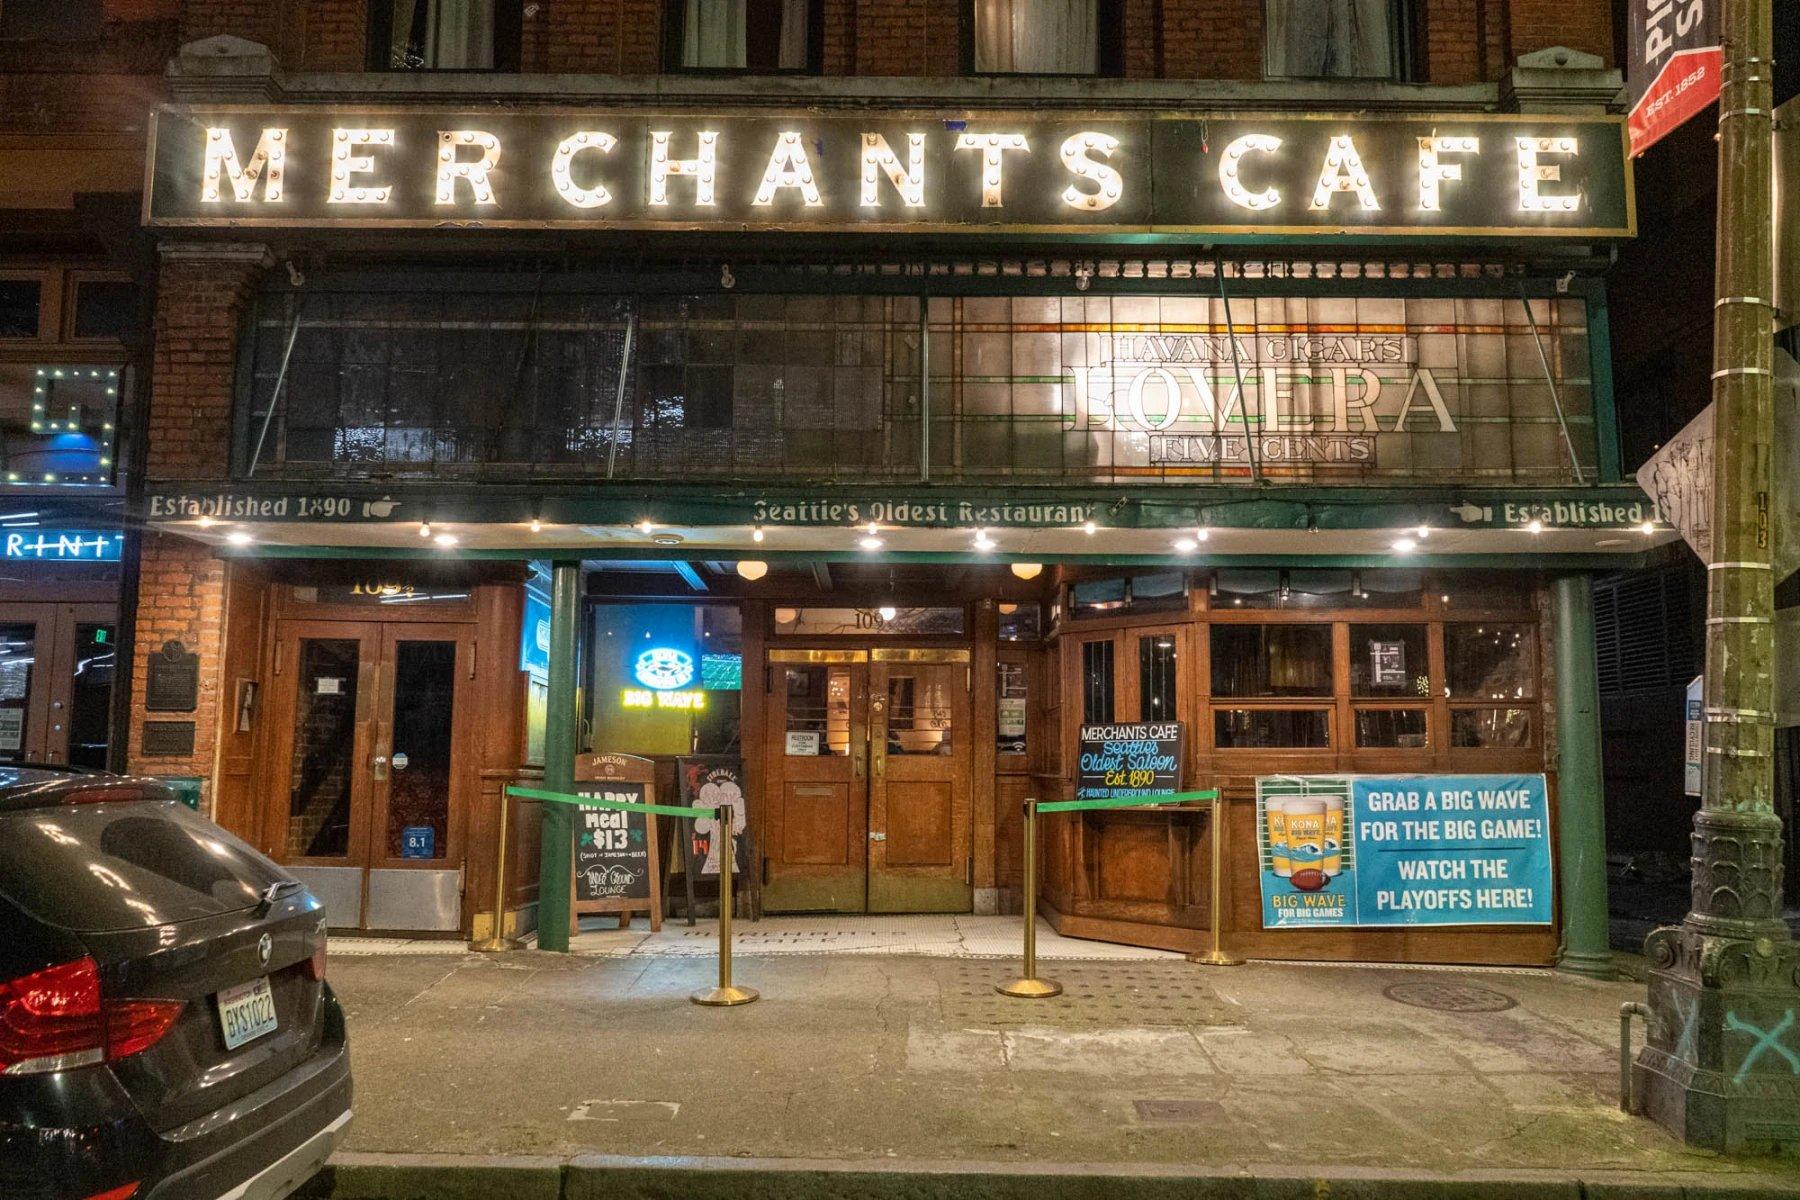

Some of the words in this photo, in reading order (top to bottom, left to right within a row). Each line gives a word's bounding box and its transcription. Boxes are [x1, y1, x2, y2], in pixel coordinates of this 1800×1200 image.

[1645, 90, 1674, 118] EST.
[201, 127, 1124, 211] MERCHANTS
[1218, 133, 1582, 212] CAFE
[1114, 336, 1252, 363] HAVANA
[1266, 336, 1402, 362] CIGARS
[1160, 435, 1240, 462] FIVE
[1262, 435, 1370, 461] CENTS
[150, 496, 288, 517] Established
[754, 501, 859, 521] Seattle's
[870, 501, 947, 521] Oldest
[960, 501, 1096, 522] Restaurant
[1504, 501, 1642, 523] Established
[854, 611, 884, 630] 109
[1081, 726, 1147, 740] MERCHANTS
[1149, 725, 1178, 739] CAFE
[592, 756, 627, 767] JAMESON
[1080, 753, 1125, 772] Oldest
[1127, 754, 1178, 771] Saloon
[1128, 770, 1155, 788] 1890
[1368, 791, 1421, 813] GRAB
[1424, 791, 1438, 811] A
[1441, 790, 1474, 811] BIG
[1477, 789, 1532, 810] WAVE
[1291, 819, 1320, 830] KONA
[1360, 821, 1399, 842] FOR
[1402, 821, 1441, 841] THE
[1444, 819, 1477, 840] BIG
[1481, 818, 1542, 840] GAME!
[409, 837, 425, 848] 8.1
[593, 828, 629, 850] $13
[1398, 859, 1466, 881] WATCH
[1469, 858, 1509, 879] THE
[1272, 894, 1298, 909] BIG
[1304, 893, 1347, 908] WAVE
[1376, 889, 1473, 911] PLAYOFFS
[1476, 888, 1534, 909] HERE!
[1278, 907, 1296, 918] FOR
[1296, 907, 1312, 918] BIG
[1313, 906, 1344, 918] GAMES
[225, 994, 274, 1038] BYS1022
